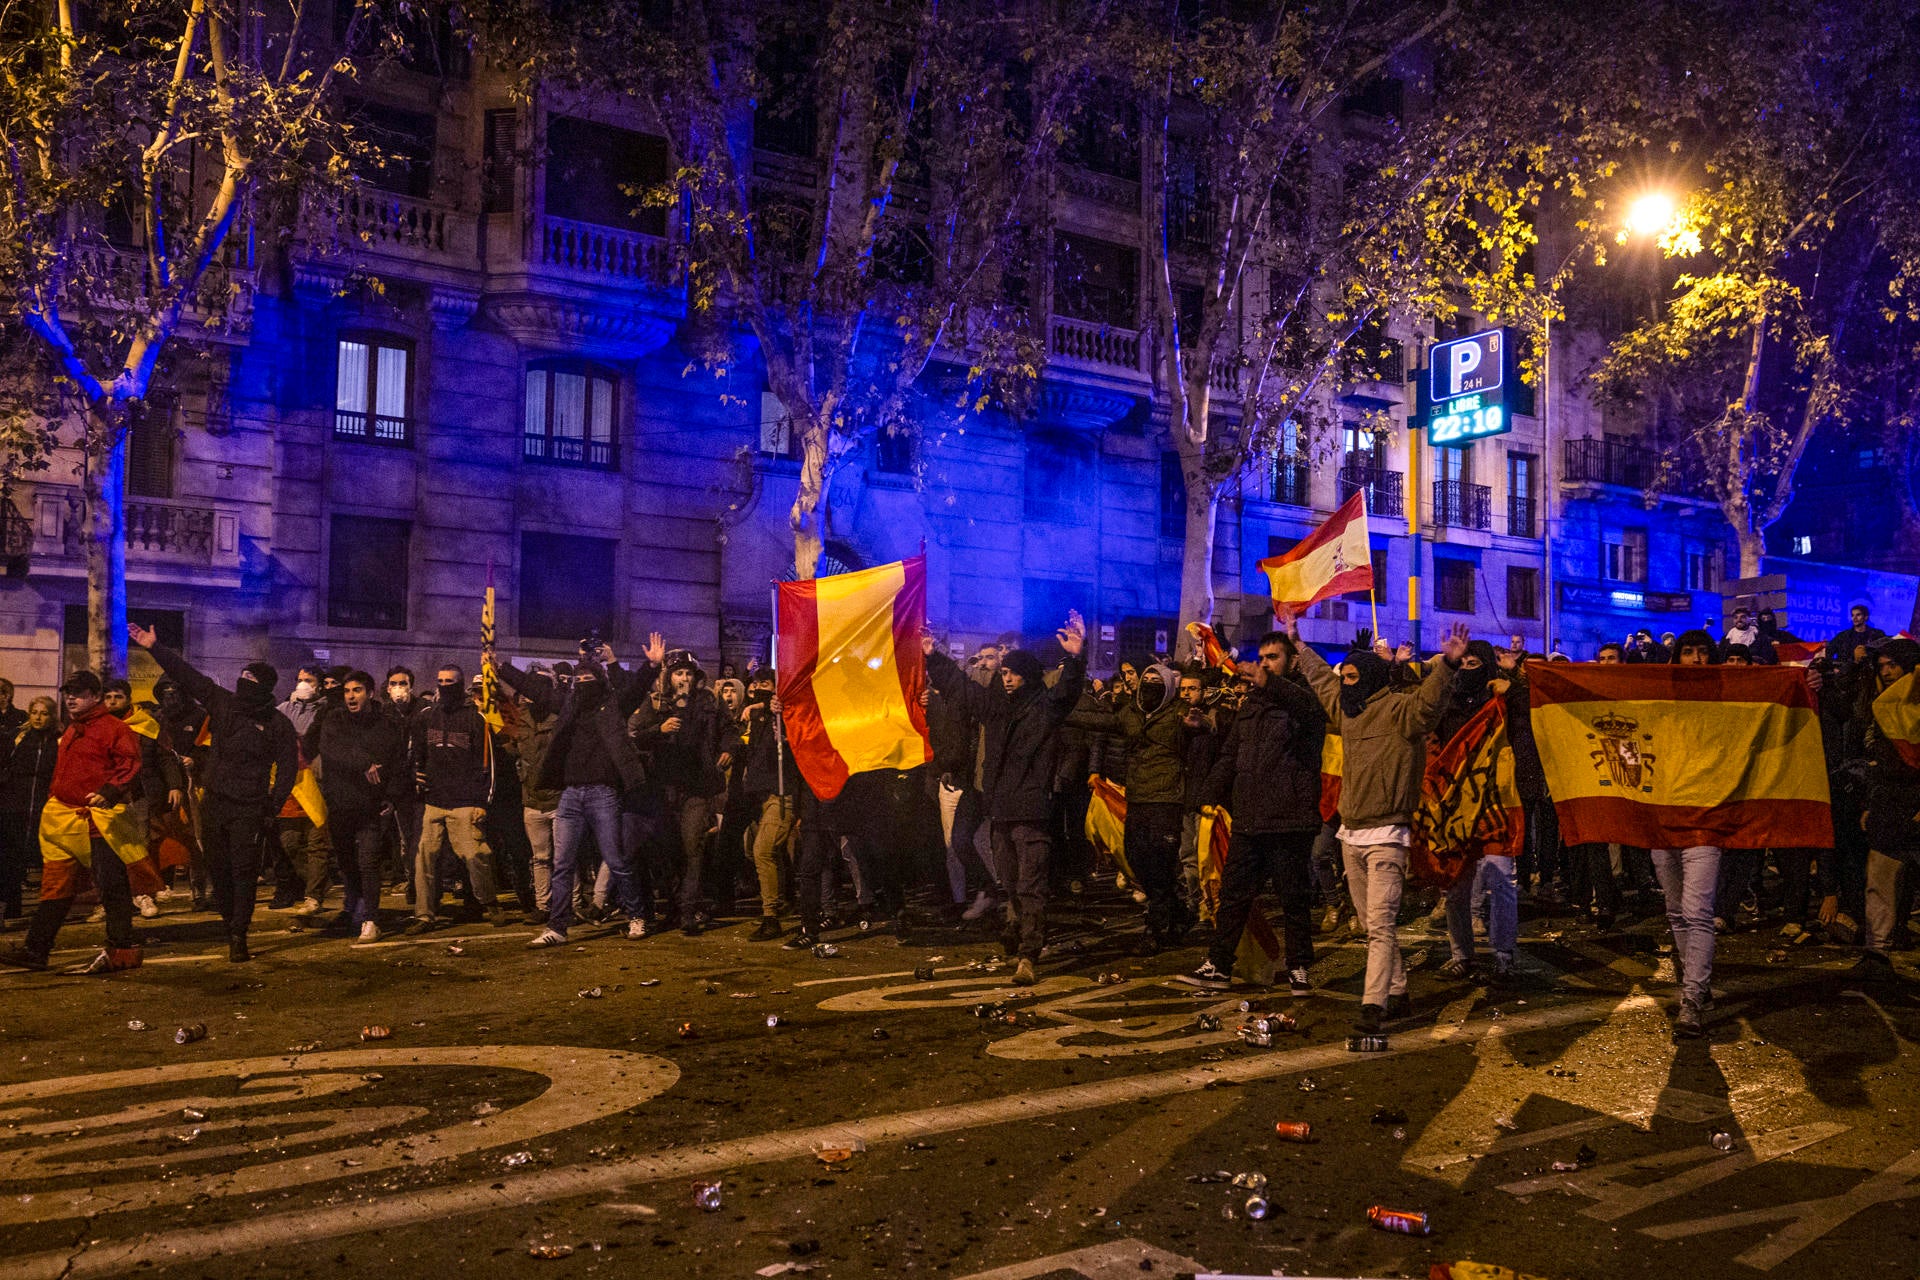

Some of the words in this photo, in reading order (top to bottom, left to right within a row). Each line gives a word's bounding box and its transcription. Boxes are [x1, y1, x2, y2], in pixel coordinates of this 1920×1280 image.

[1450, 341, 1482, 394] P
[1463, 380, 1474, 390] 24
[1476, 377, 1483, 387] H
[1449, 395, 1481, 415] LIBRE
[1432, 406, 1503, 442] 22:10
